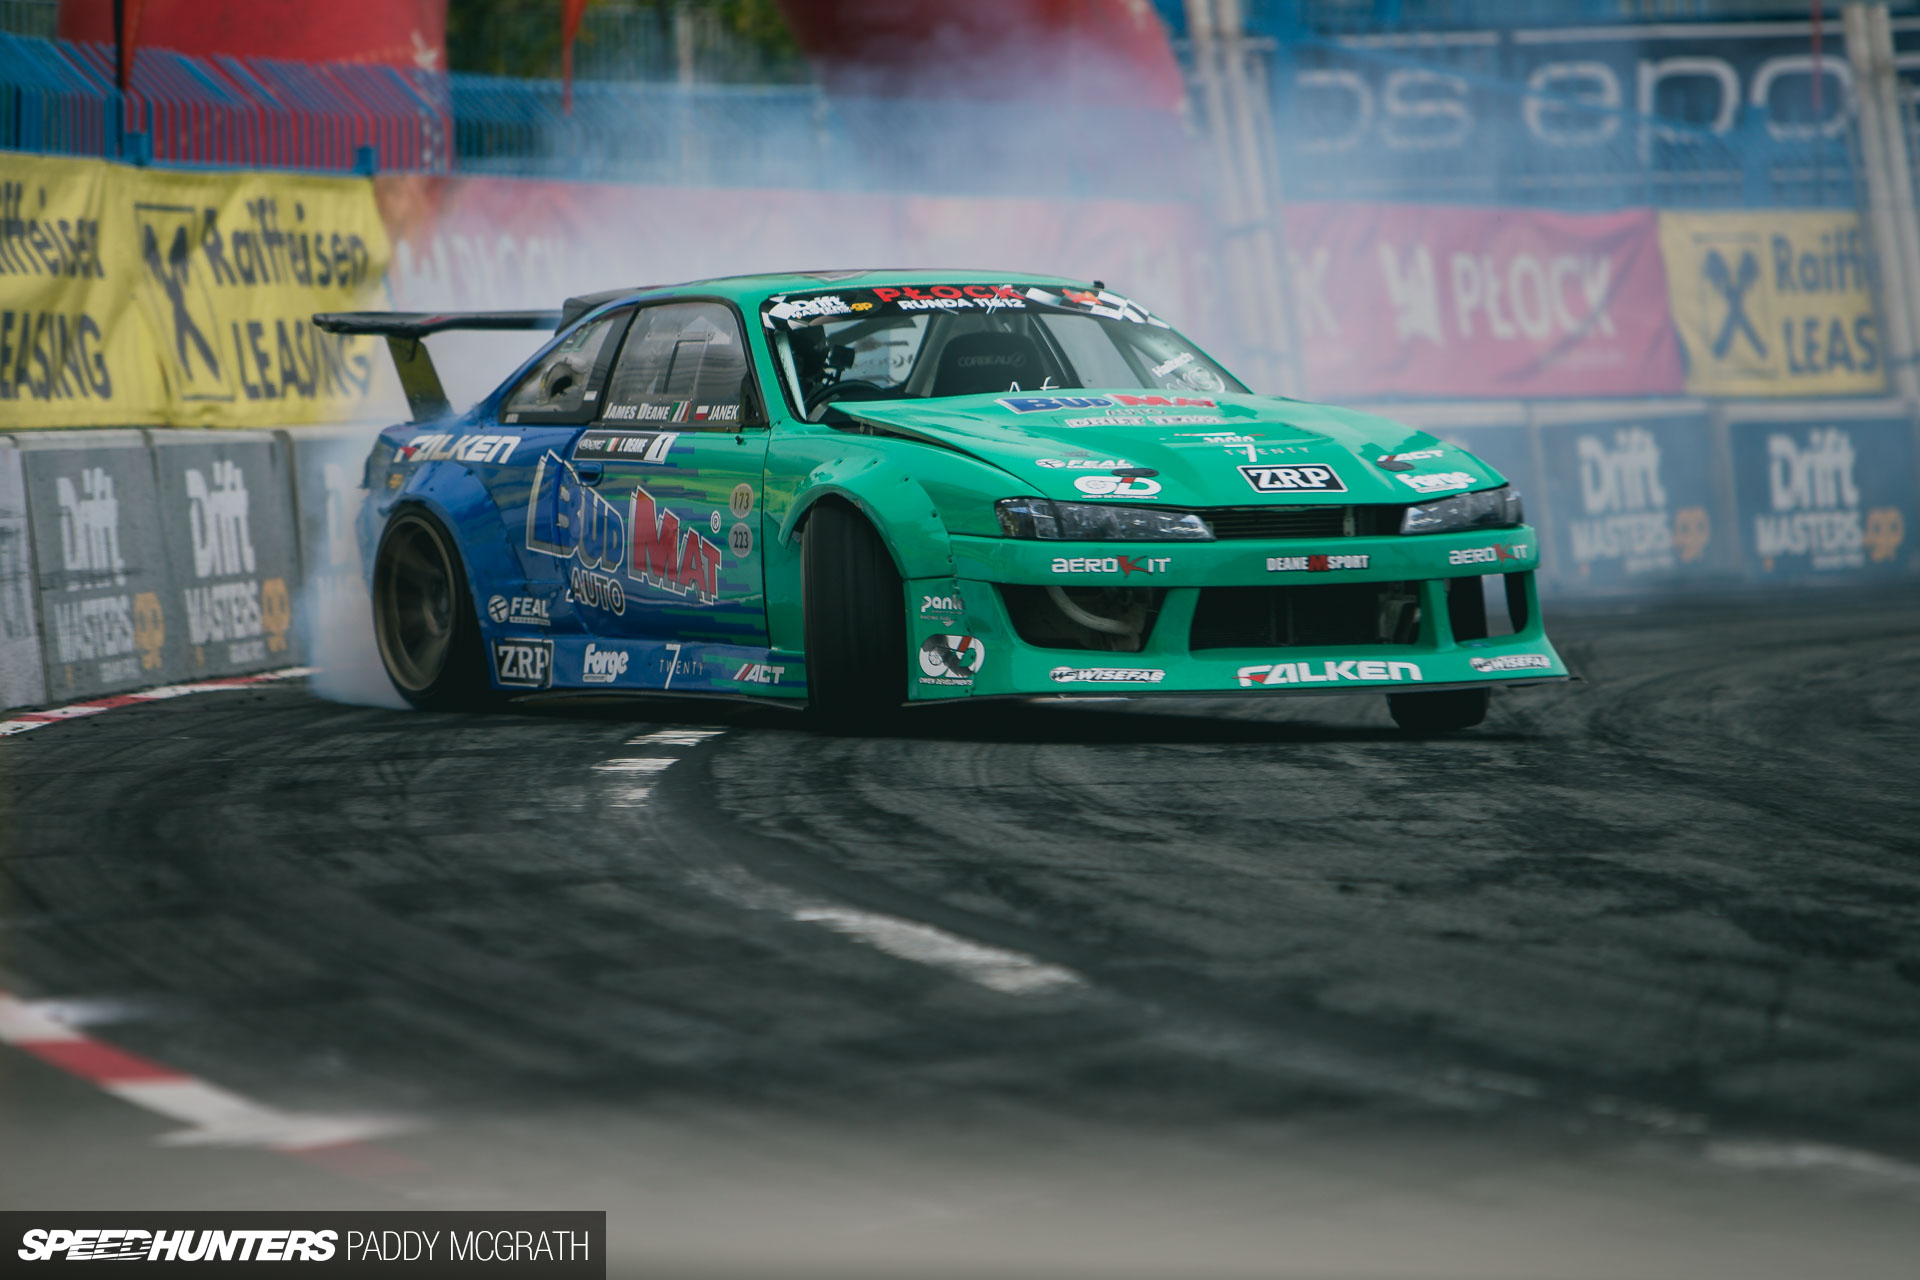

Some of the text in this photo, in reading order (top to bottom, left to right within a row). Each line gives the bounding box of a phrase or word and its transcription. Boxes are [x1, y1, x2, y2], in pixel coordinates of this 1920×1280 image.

[203, 197, 369, 287] Raiffeisen
[872, 285, 1025, 303] PŁOCK
[898, 299, 973, 311] RUNDA
[1452, 252, 1617, 341] PŁOCK
[232, 319, 373, 398] LEASING
[603, 402, 670, 420] JAMES DEANE
[708, 405, 740, 420] JANEK
[994, 398, 1113, 415] BUD
[392, 434, 522, 464] FALKEN
[1246, 467, 1331, 489] ZRP
[1576, 427, 1665, 515] Drift
[1768, 427, 1859, 512] Drift
[733, 492, 750, 509] 173
[185, 460, 256, 578] Drift
[526, 449, 722, 606] BUD MAT
[1570, 511, 1673, 562] MASTERS
[1755, 511, 1863, 561] MASTERS
[733, 531, 749, 549] 223
[510, 597, 549, 617] FEAL
[570, 567, 626, 616] AUTO
[183, 579, 264, 645] MASTERS
[498, 645, 549, 680] ZRP
[1237, 660, 1423, 688] FALKEN
